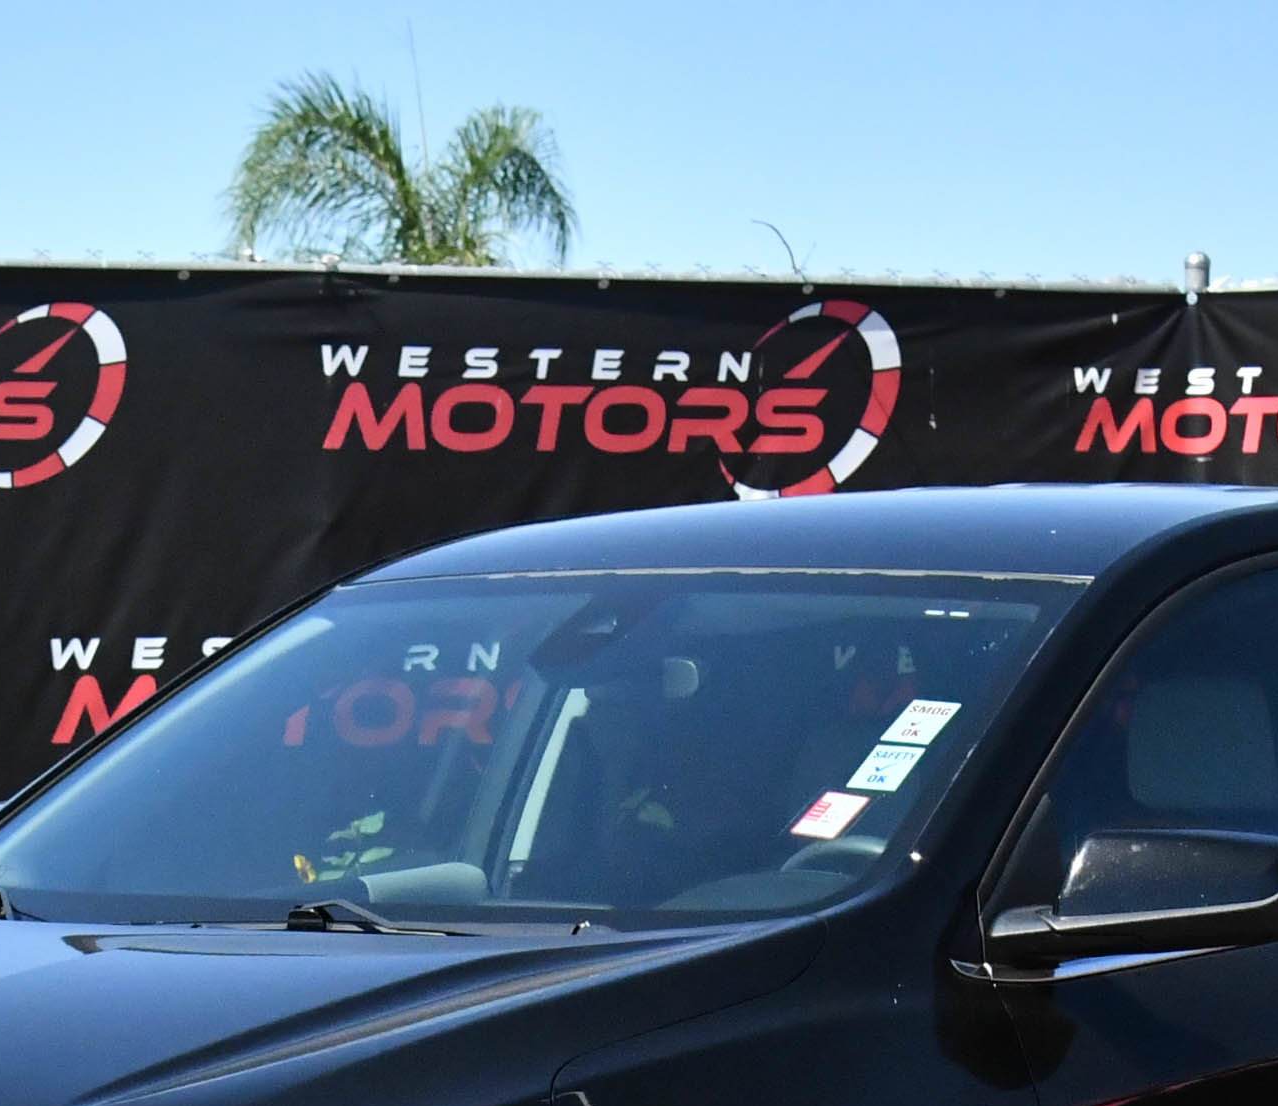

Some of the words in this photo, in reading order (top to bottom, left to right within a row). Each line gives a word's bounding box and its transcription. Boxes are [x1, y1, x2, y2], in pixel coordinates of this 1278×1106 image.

[321, 344, 752, 383] WESTERN
[323, 381, 827, 454] MOTORS
[909, 704, 951, 717] SMOG
[901, 728, 921, 738] OK
[873, 750, 916, 761] SAFETY
[866, 774, 887, 784] OK
